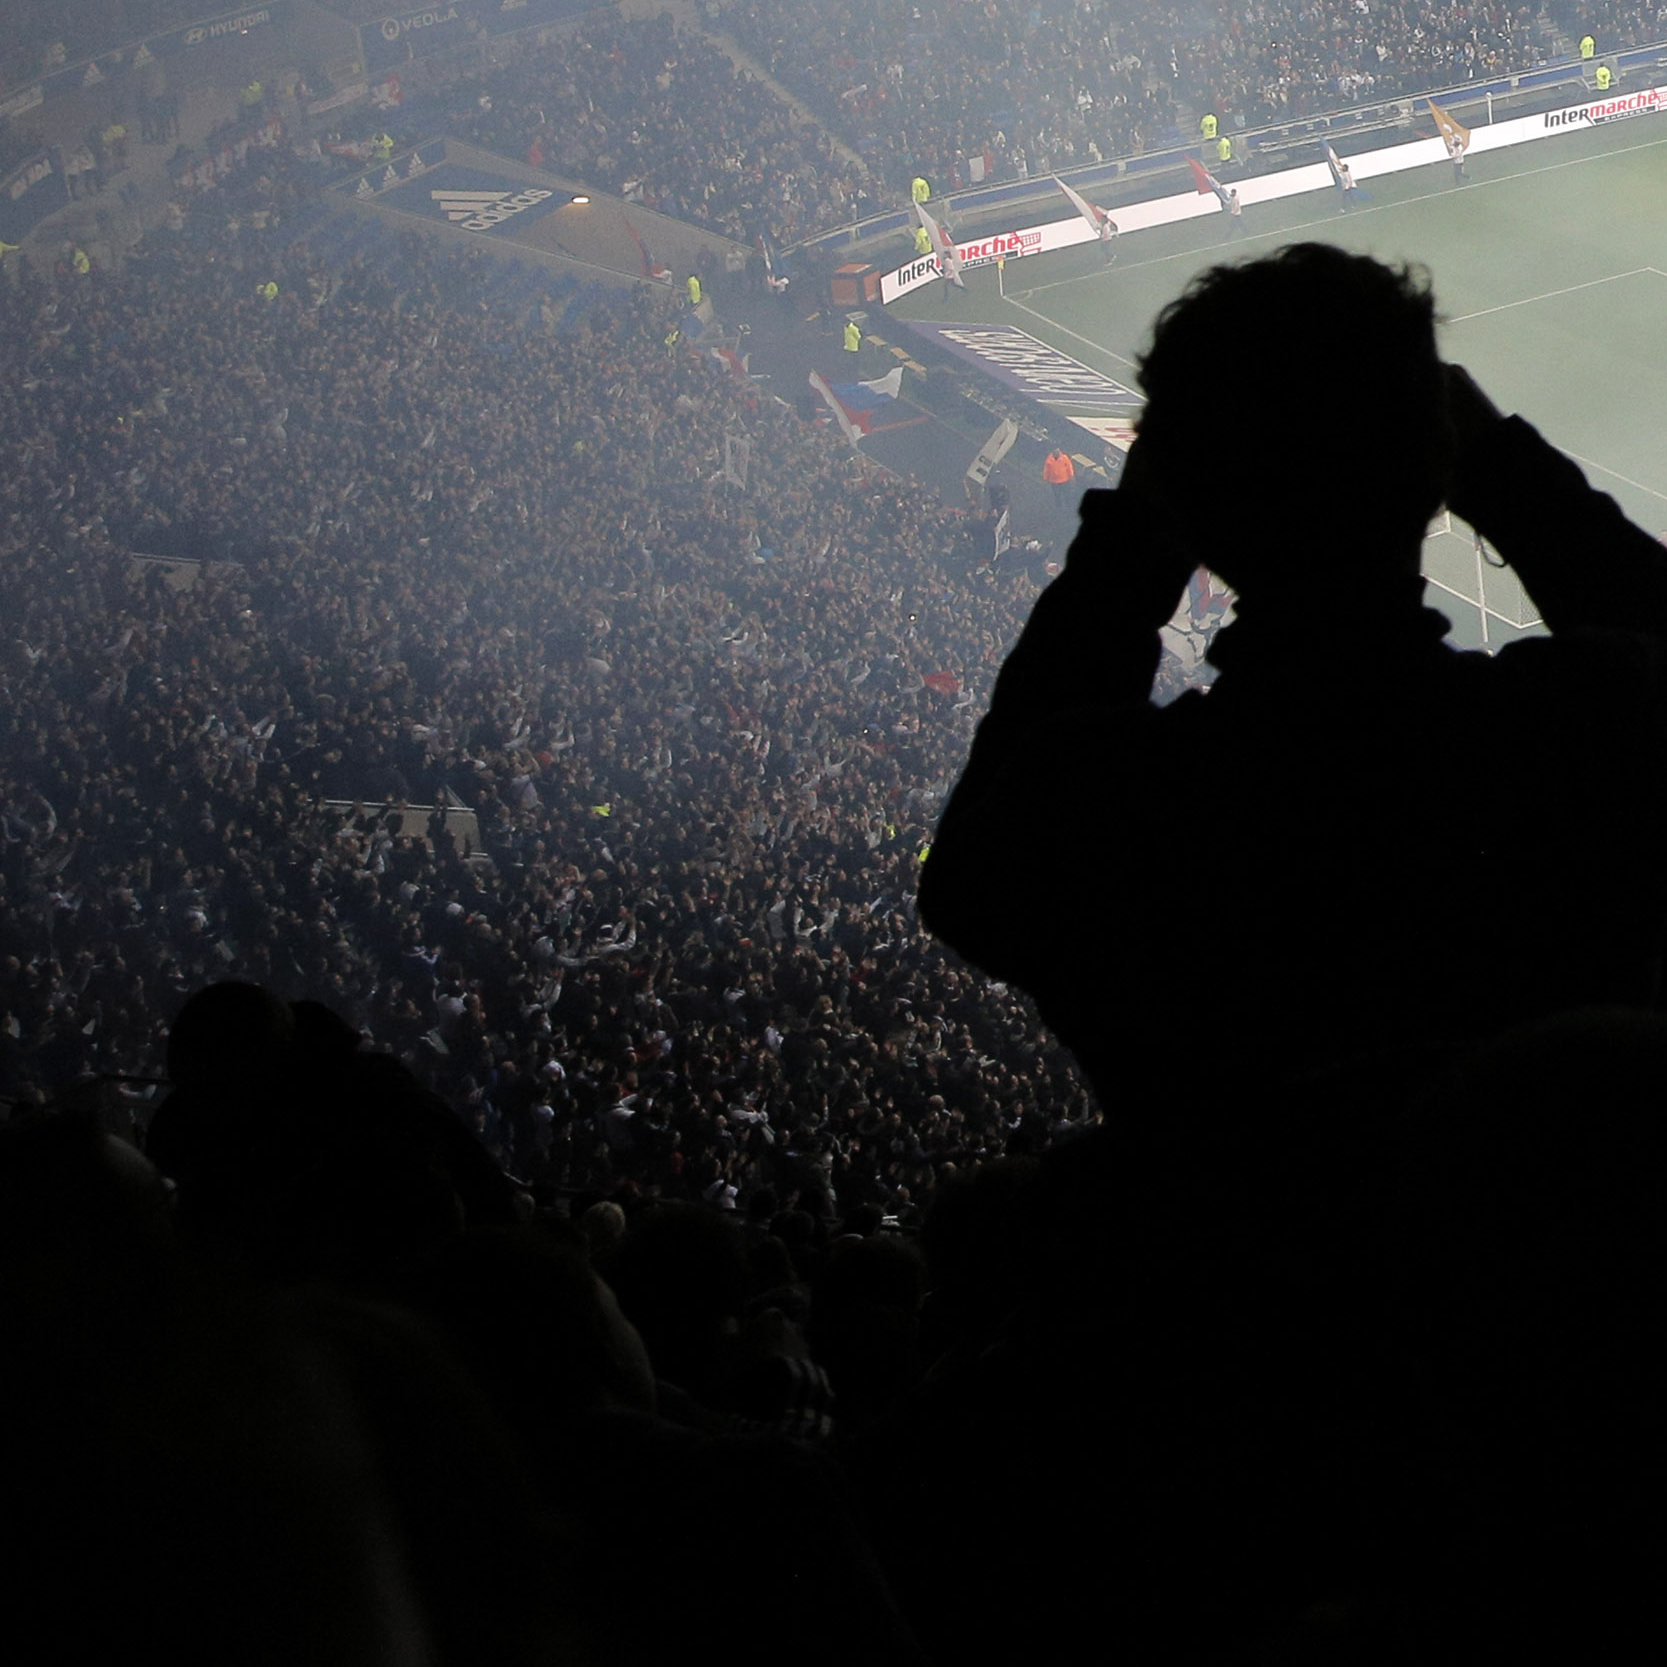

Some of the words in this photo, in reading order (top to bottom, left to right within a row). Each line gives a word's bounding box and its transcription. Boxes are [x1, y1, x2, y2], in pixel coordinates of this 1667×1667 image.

[209, 9, 271, 38] HYUNDAI
[1544, 88, 1658, 128] Intermarché
[461, 188, 552, 230] adidas
[898, 231, 1024, 287] Interarché
